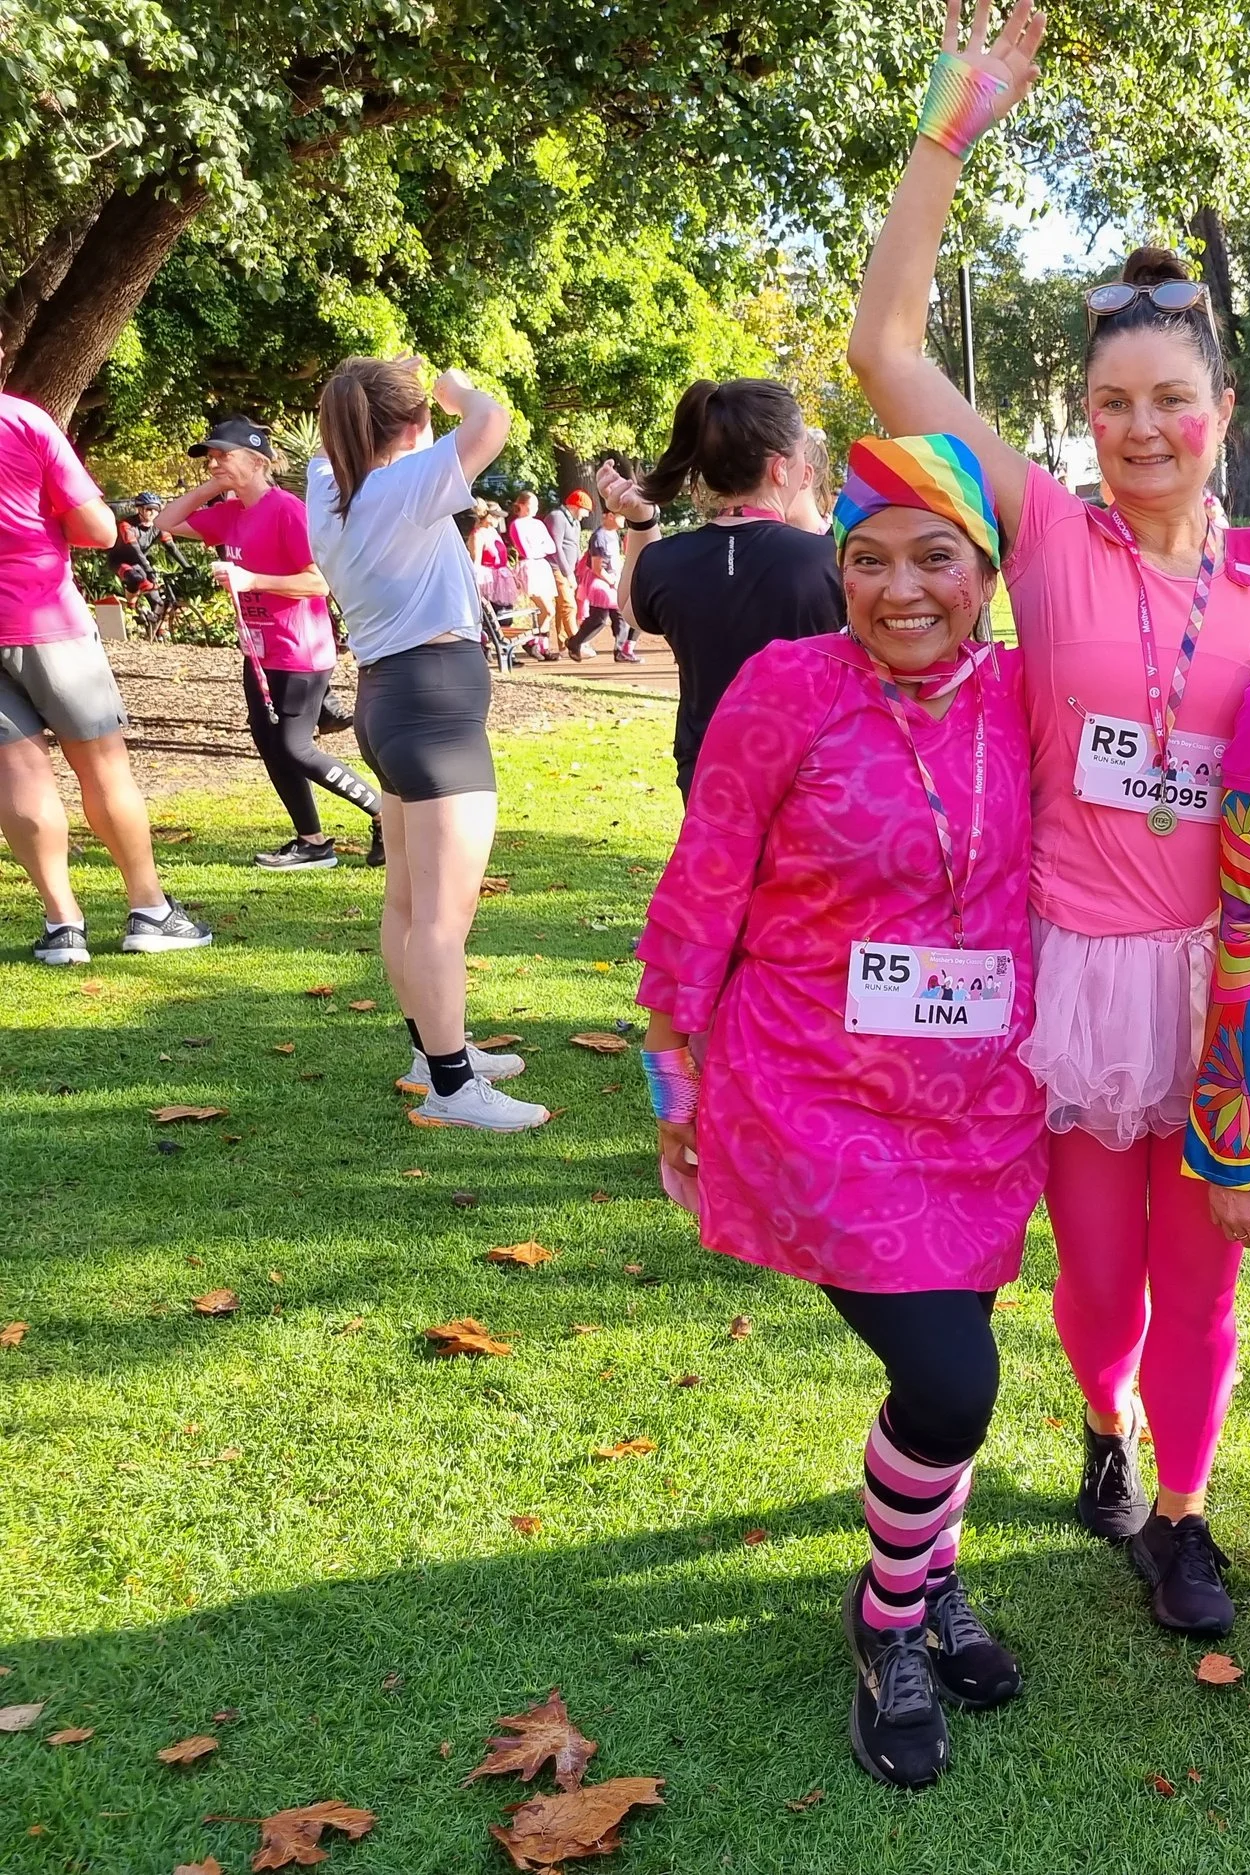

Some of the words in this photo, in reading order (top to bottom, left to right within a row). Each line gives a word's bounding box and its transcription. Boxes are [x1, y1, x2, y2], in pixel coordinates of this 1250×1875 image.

[226, 545, 243, 560] ALK
[976, 711, 984, 740] Classic
[975, 742, 985, 758] Day
[1091, 725, 1138, 758] R5
[1093, 754, 1109, 764] RUN
[1110, 757, 1126, 766] 5KM
[975, 759, 984, 794] Mother's
[1122, 777, 1208, 809] 104095
[861, 952, 910, 984] R5
[864, 983, 882, 992] RUN
[883, 984, 900, 993] 5KM
[914, 1004, 968, 1025] LINA
